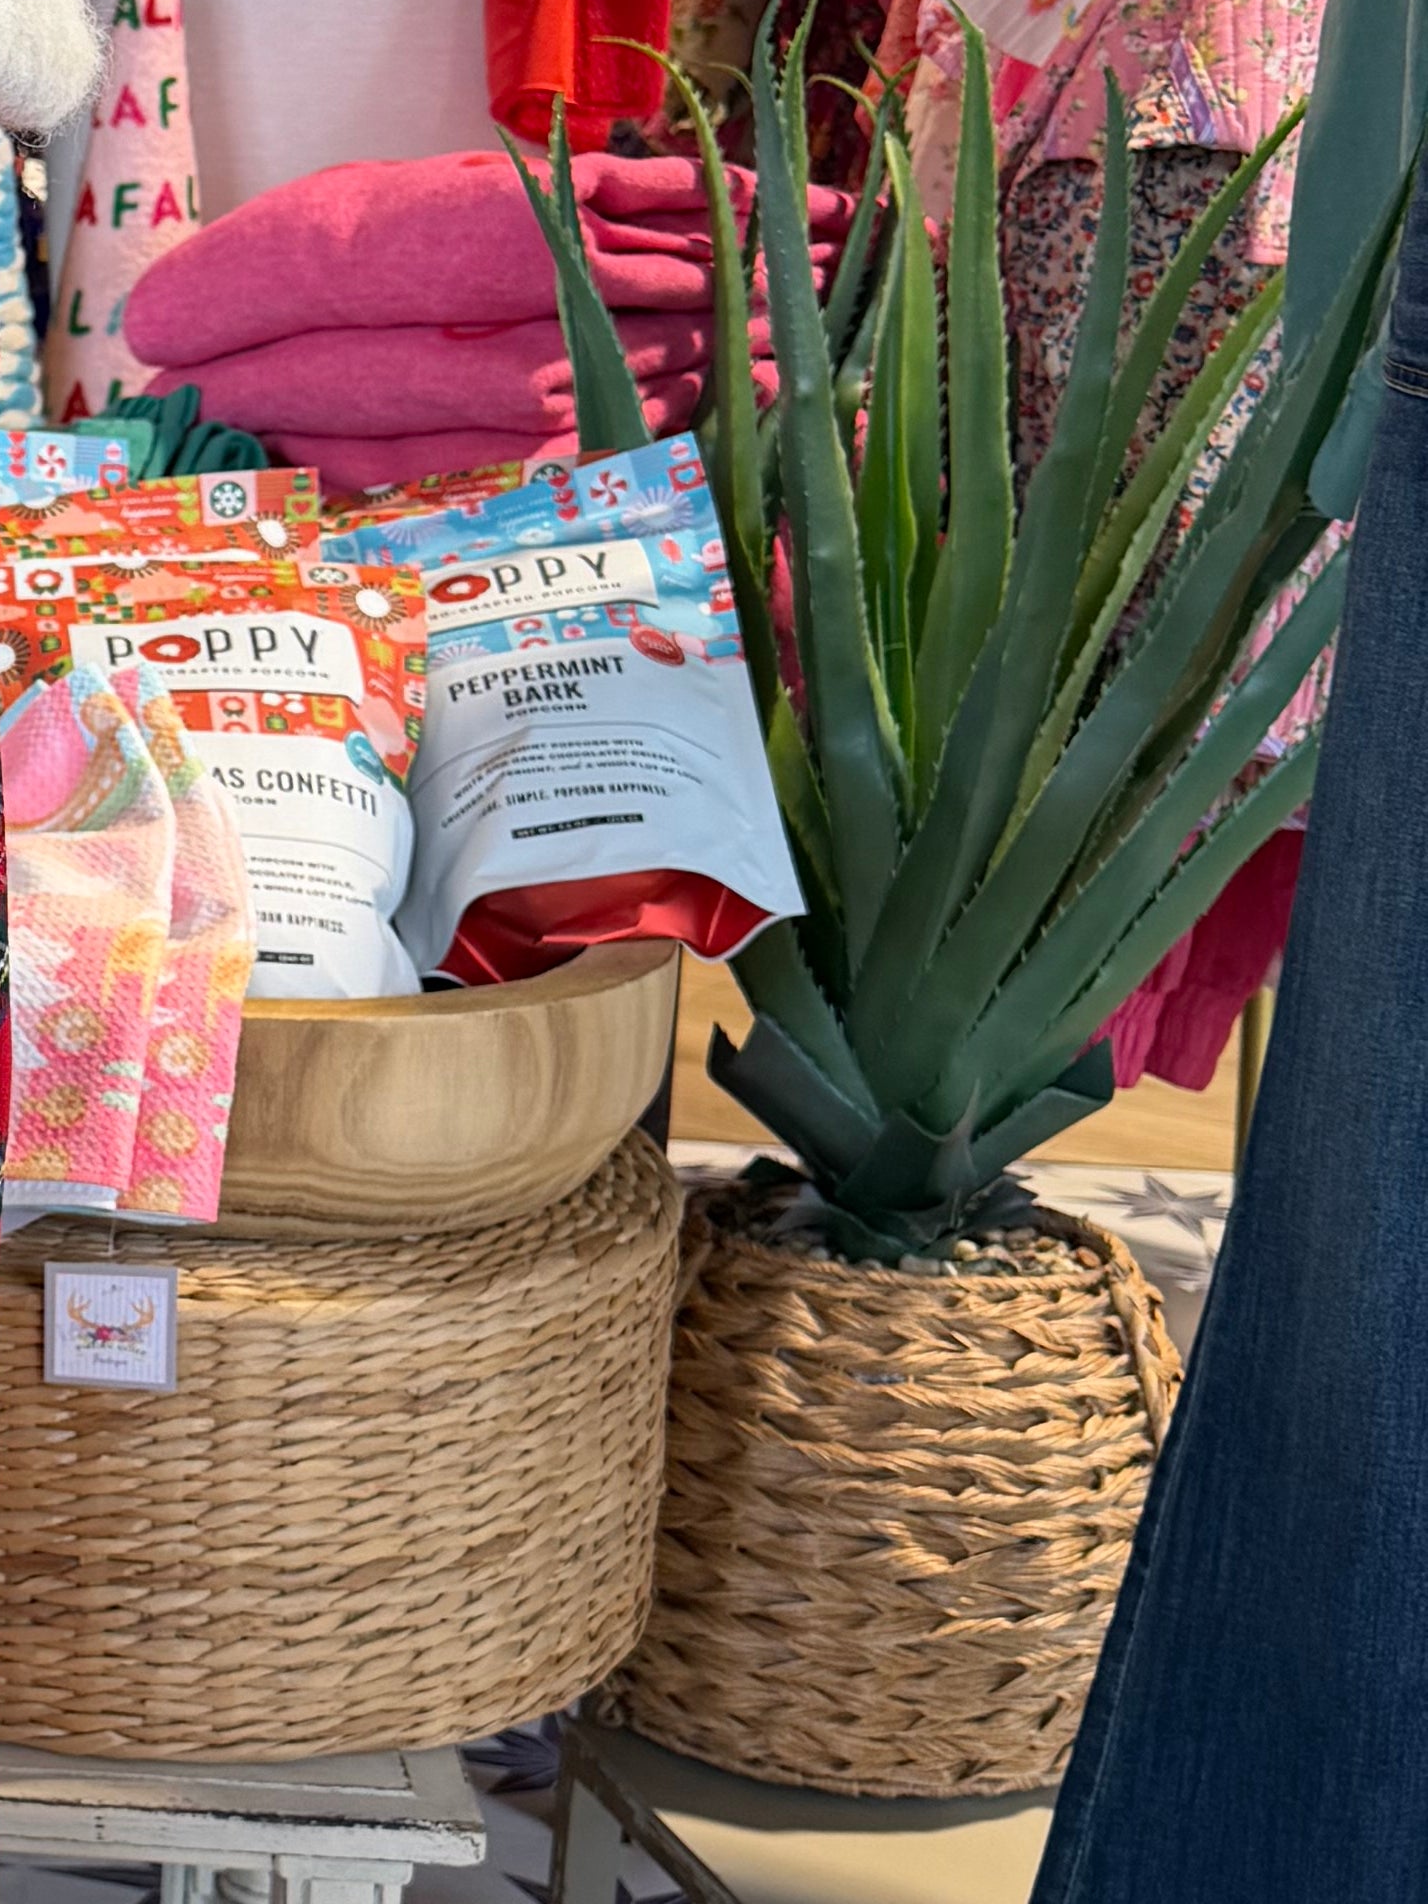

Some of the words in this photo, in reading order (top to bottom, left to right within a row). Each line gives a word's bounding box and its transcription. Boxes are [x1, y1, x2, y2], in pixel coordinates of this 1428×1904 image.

[105, 625, 321, 667] POPPY
[447, 654, 625, 703] PEPPERMINT
[502, 680, 585, 708] BARK
[504, 703, 588, 720] POPCORN
[256, 768, 377, 817] CONFETTI
